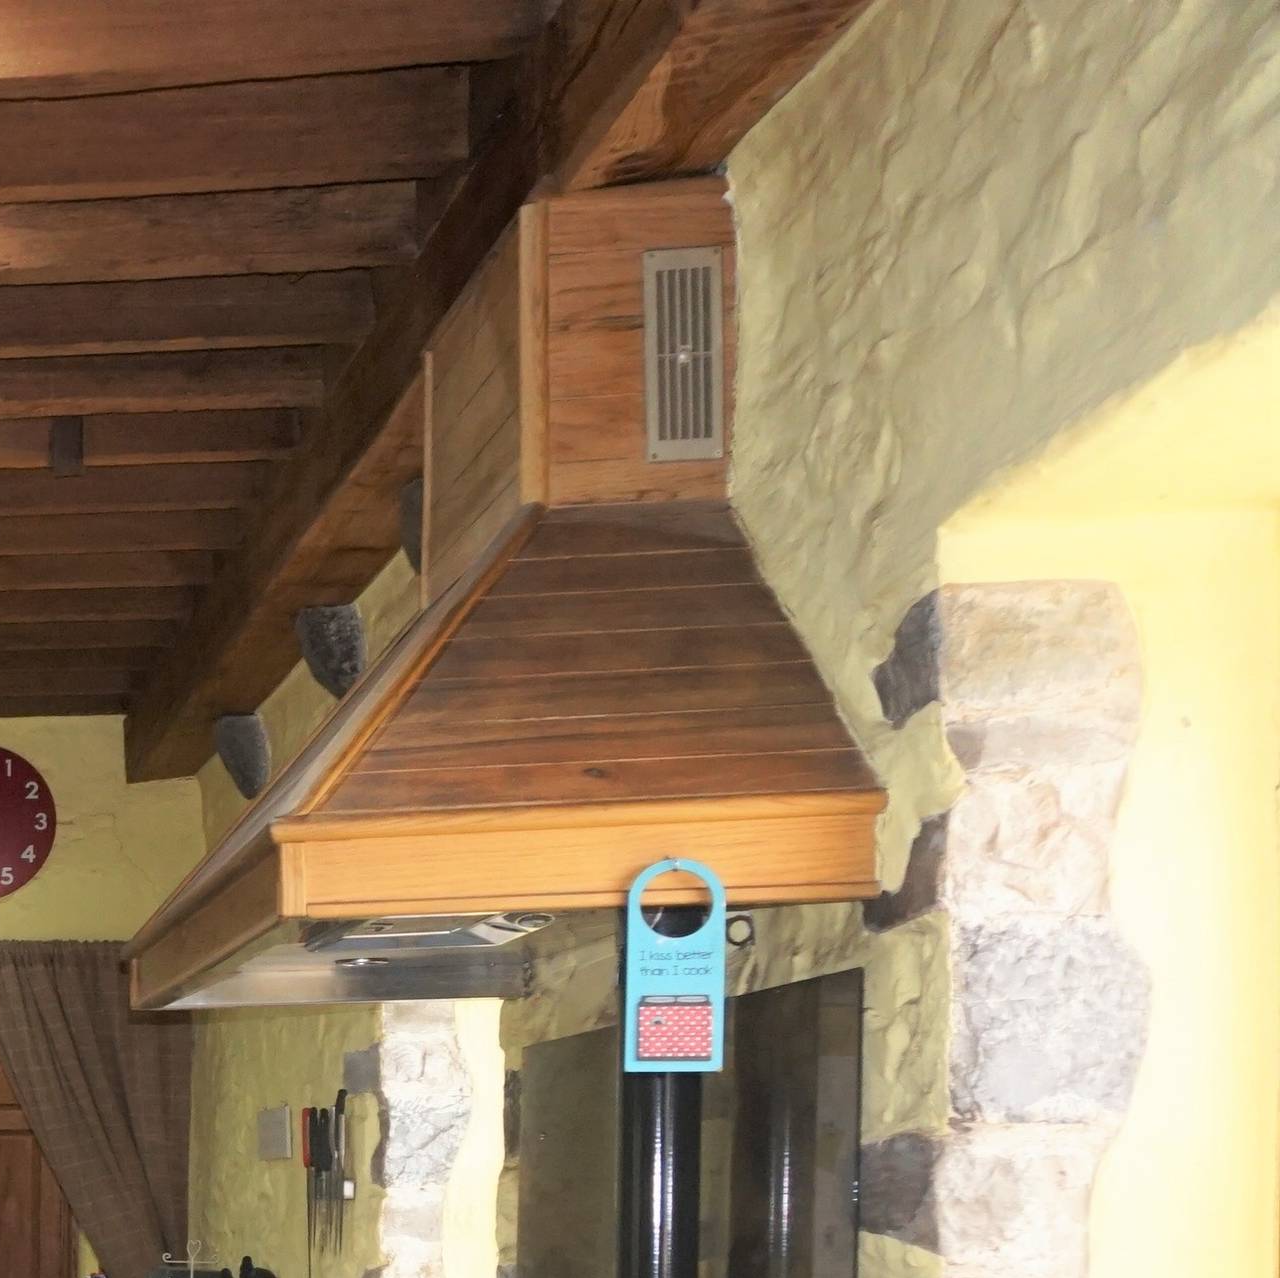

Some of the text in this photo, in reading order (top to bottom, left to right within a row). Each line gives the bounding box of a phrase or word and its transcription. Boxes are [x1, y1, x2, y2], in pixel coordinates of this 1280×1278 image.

[5, 759, 12, 777] 1
[25, 781, 39, 799] 2
[34, 812, 48, 830] 3
[20, 844, 36, 863] 4
[0, 866, 14, 885] 5
